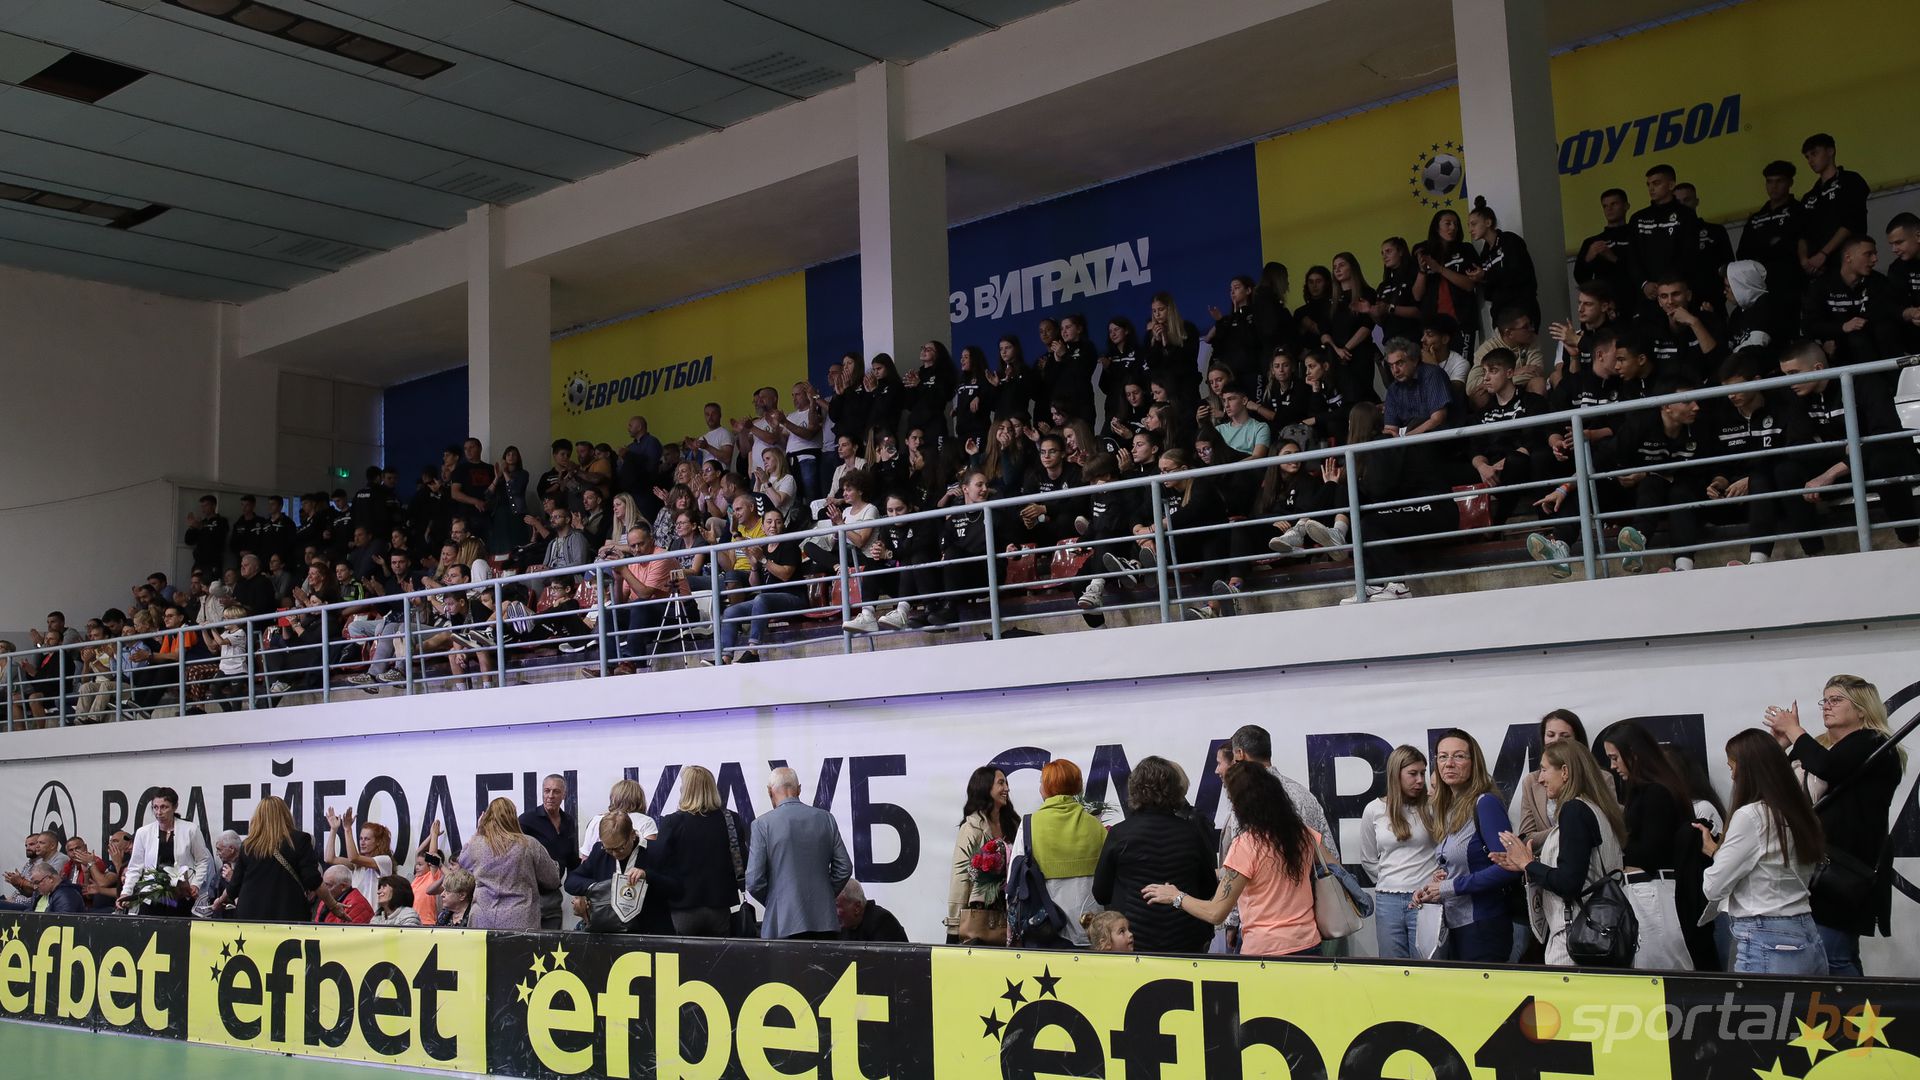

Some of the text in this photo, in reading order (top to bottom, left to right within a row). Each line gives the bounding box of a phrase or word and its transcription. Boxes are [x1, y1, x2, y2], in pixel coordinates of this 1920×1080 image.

[1557, 94, 1741, 176] ФУТБОЛ
[584, 355, 713, 412] ЕВРОФУТБОЛ
[1763, 436, 1772, 448] 12
[1, 925, 172, 1031] efbet
[218, 938, 458, 1062] efbet
[527, 950, 890, 1080] efbet
